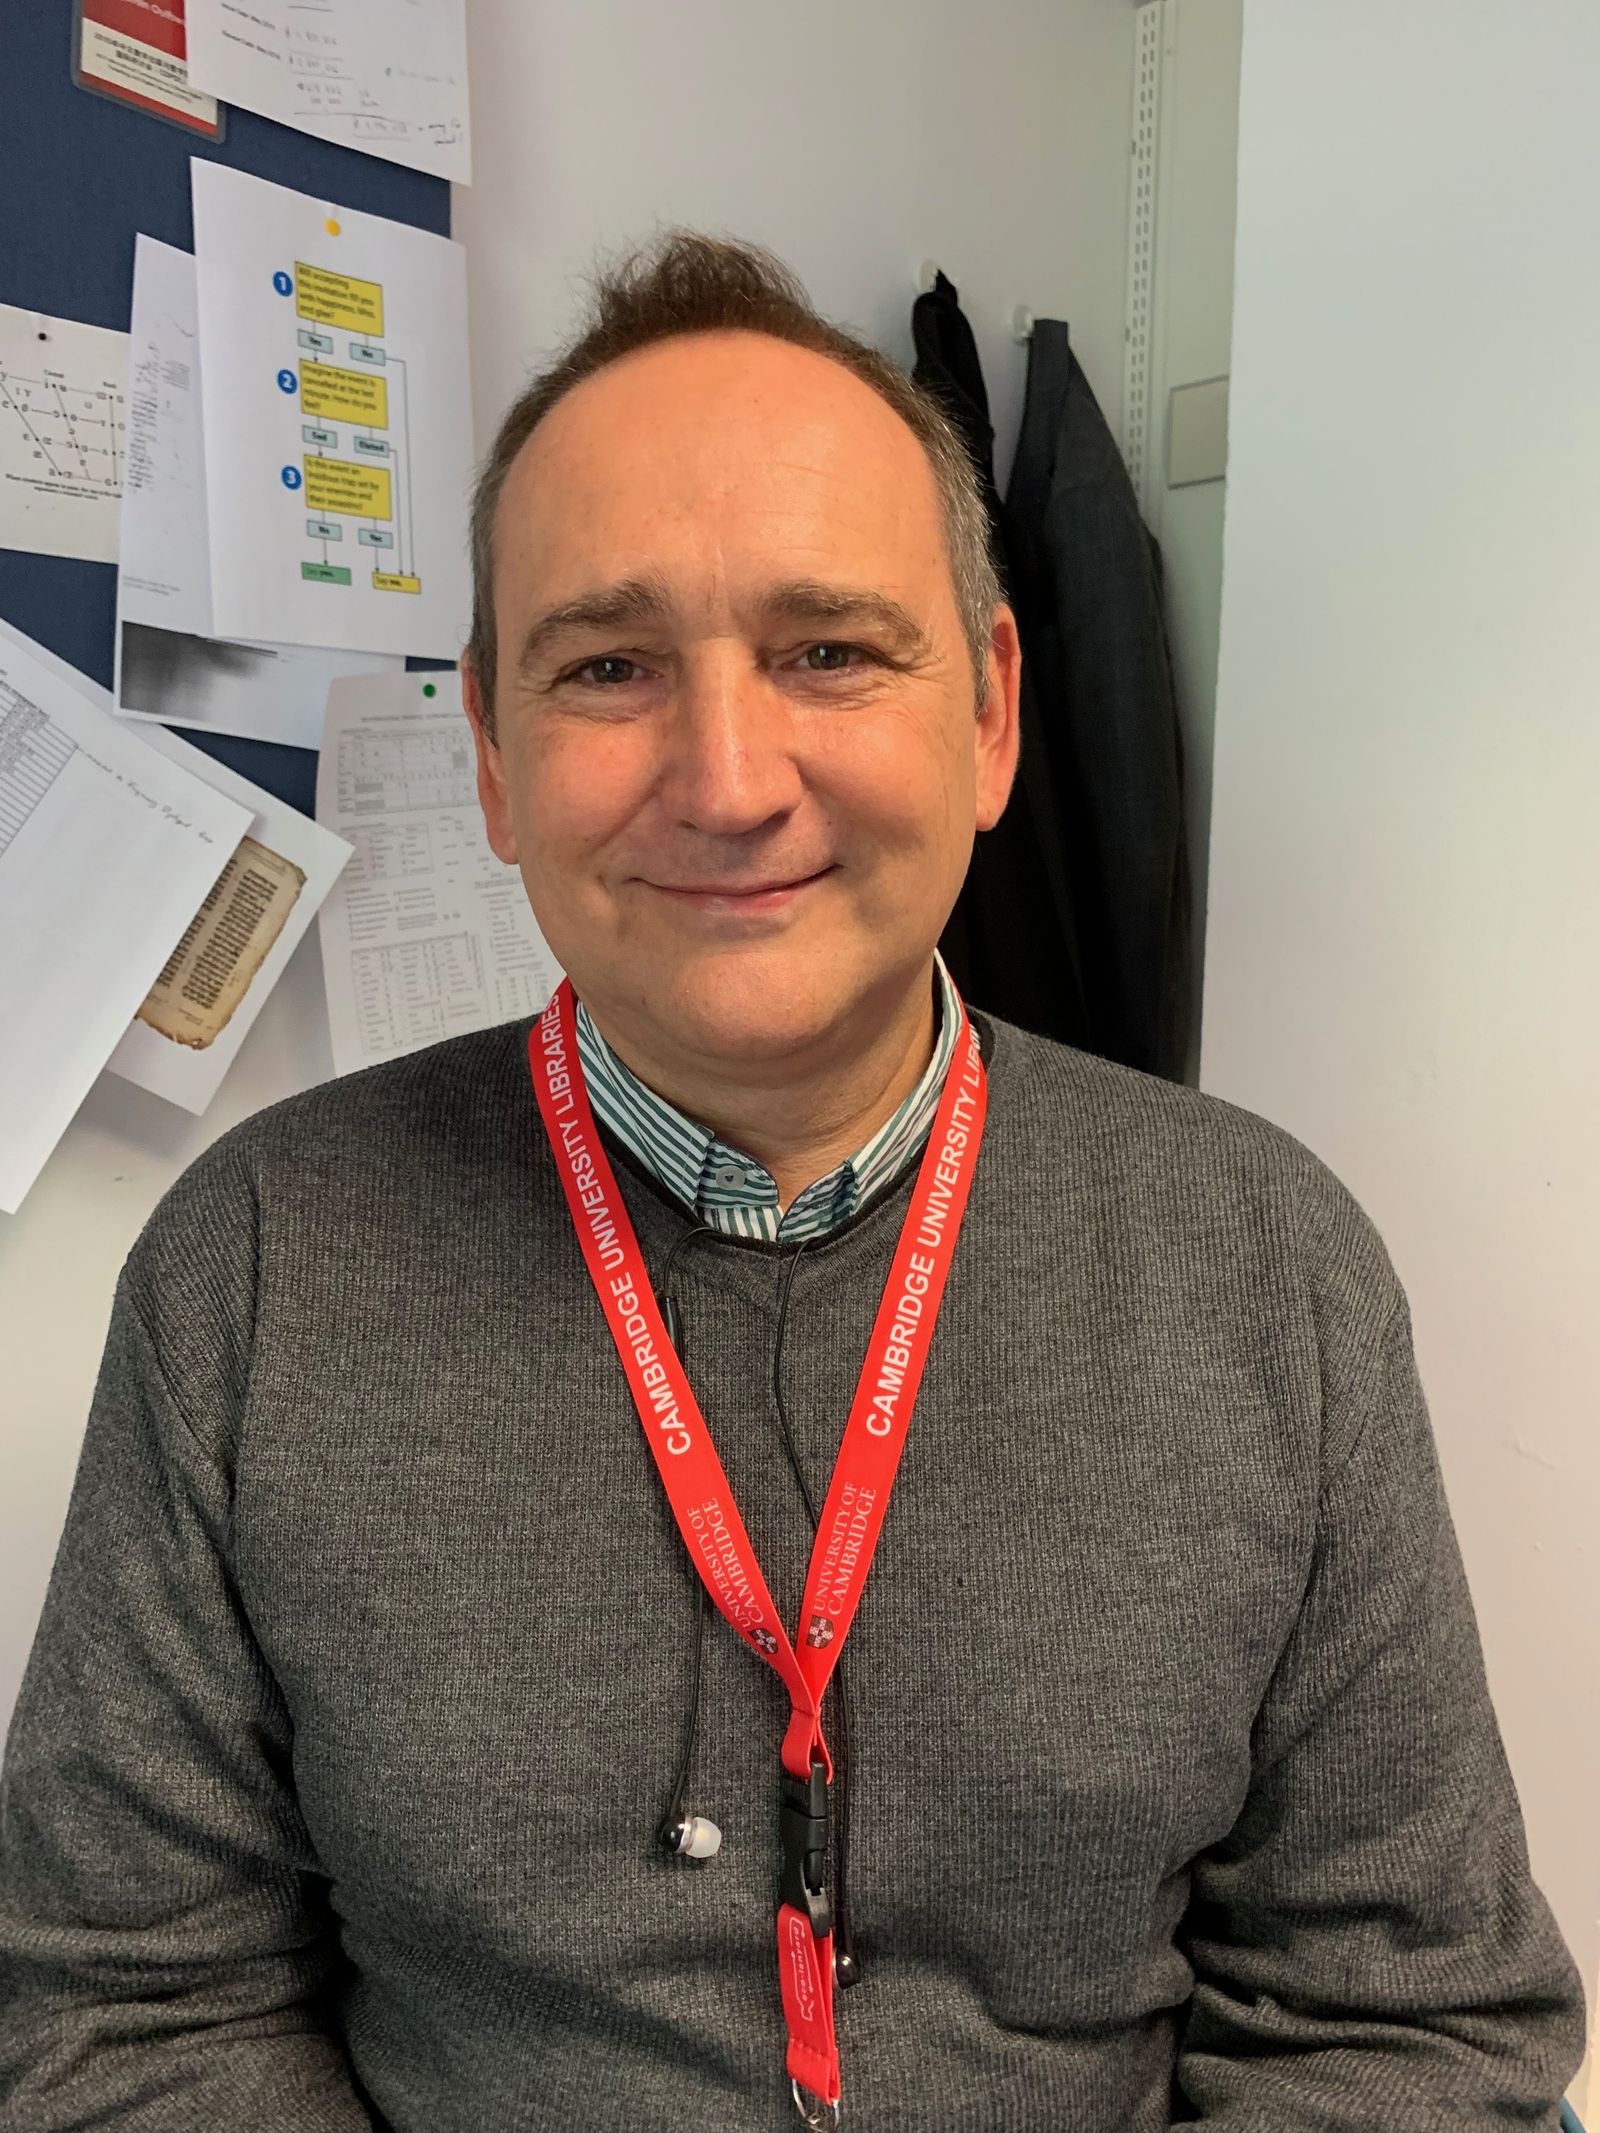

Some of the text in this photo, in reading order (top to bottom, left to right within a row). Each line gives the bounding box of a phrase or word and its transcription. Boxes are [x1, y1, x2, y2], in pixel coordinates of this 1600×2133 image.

[557, 1121, 625, 1272] UNIVERSITY
[865, 1253, 936, 1437] CAMBRIDGE
[916, 1086, 977, 1248] UNIVERSITY
[610, 1271, 692, 1456] CAMBRIDGE
[686, 1507, 752, 1629] UNIVERSITY OF
[701, 1497, 764, 1624] CAMBRIDGE
[813, 1481, 859, 1612] UNIVERSITY OF
[826, 1487, 877, 1615] CAMBRIDGE
